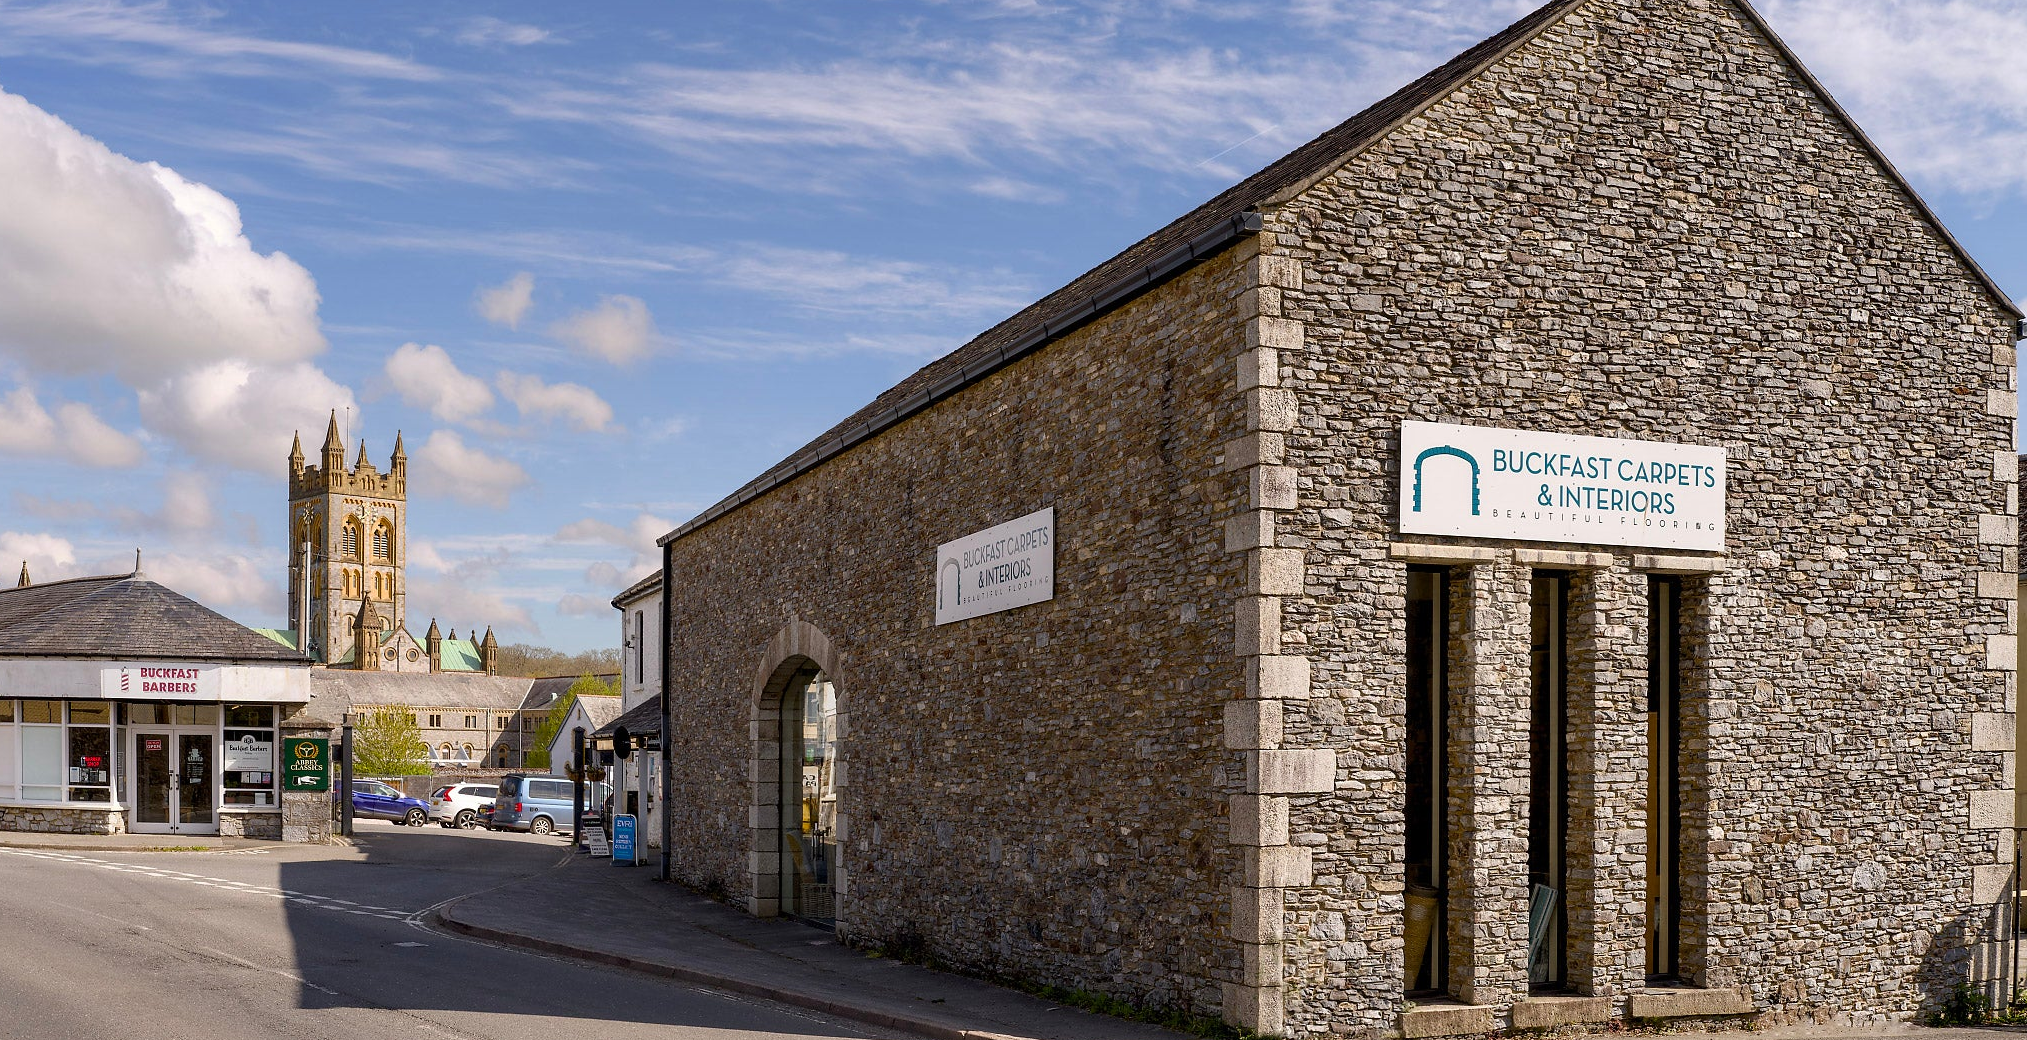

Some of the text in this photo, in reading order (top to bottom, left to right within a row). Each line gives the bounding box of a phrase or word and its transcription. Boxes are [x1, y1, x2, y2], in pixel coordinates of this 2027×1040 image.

[1493, 449, 1715, 488] BUCKFAST CARPETS
[1537, 484, 1675, 515] & INTERIORS
[1492, 508, 1715, 531] BEAUTIFUL FLOORING
[963, 526, 1048, 569] BUCKFAST CARPETS
[978, 557, 1031, 589] & INTERIORS
[1008, 575, 1049, 592] FLOORING
[140, 667, 199, 679] BUCKFAST
[142, 682, 197, 693] BARBERS
